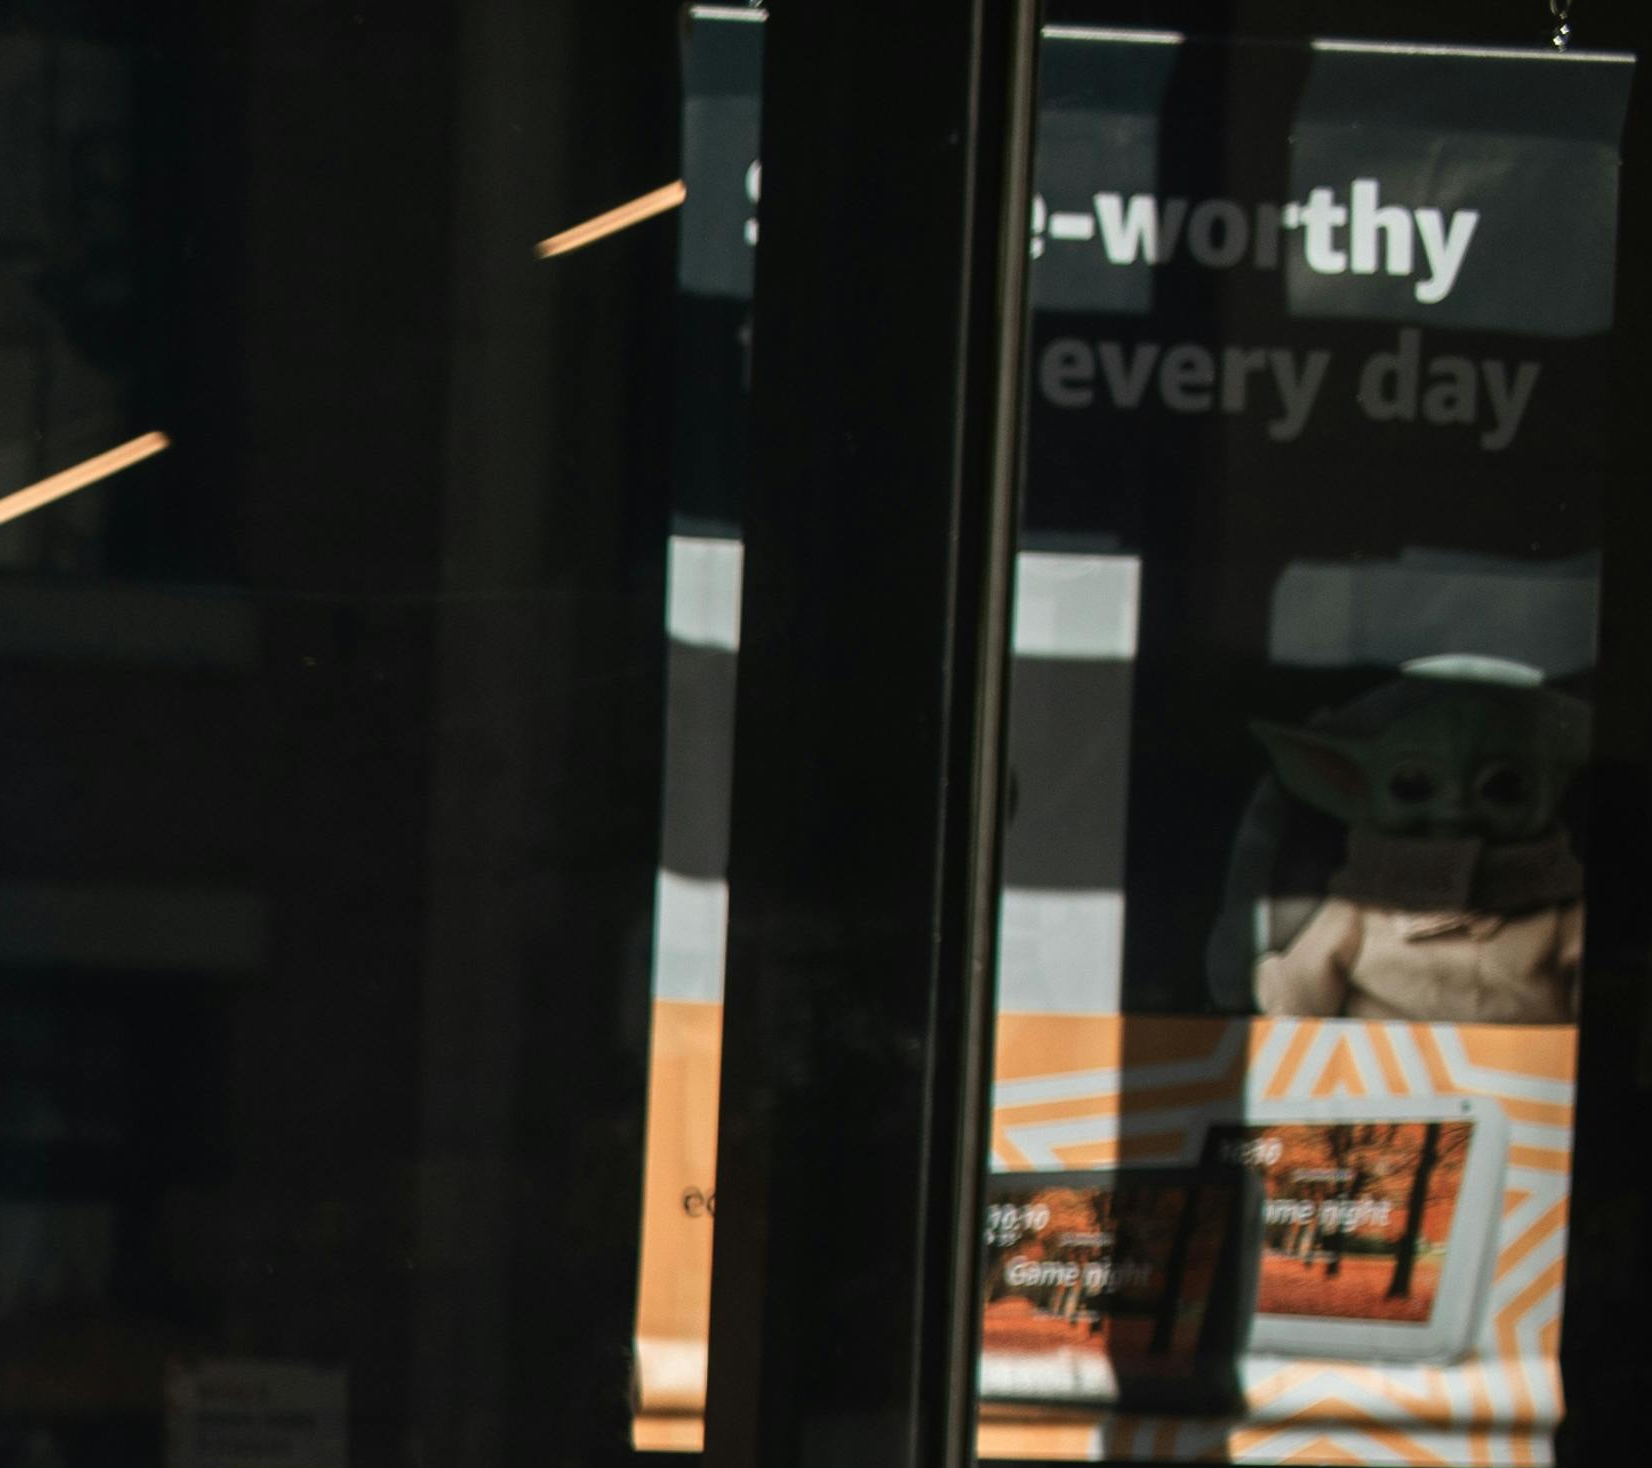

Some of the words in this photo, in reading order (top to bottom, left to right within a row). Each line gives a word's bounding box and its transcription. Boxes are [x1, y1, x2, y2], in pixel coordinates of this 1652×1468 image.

[1038, 335, 1331, 442] every
[1359, 327, 1541, 453] day
[1004, 1255, 1081, 1288] Game
